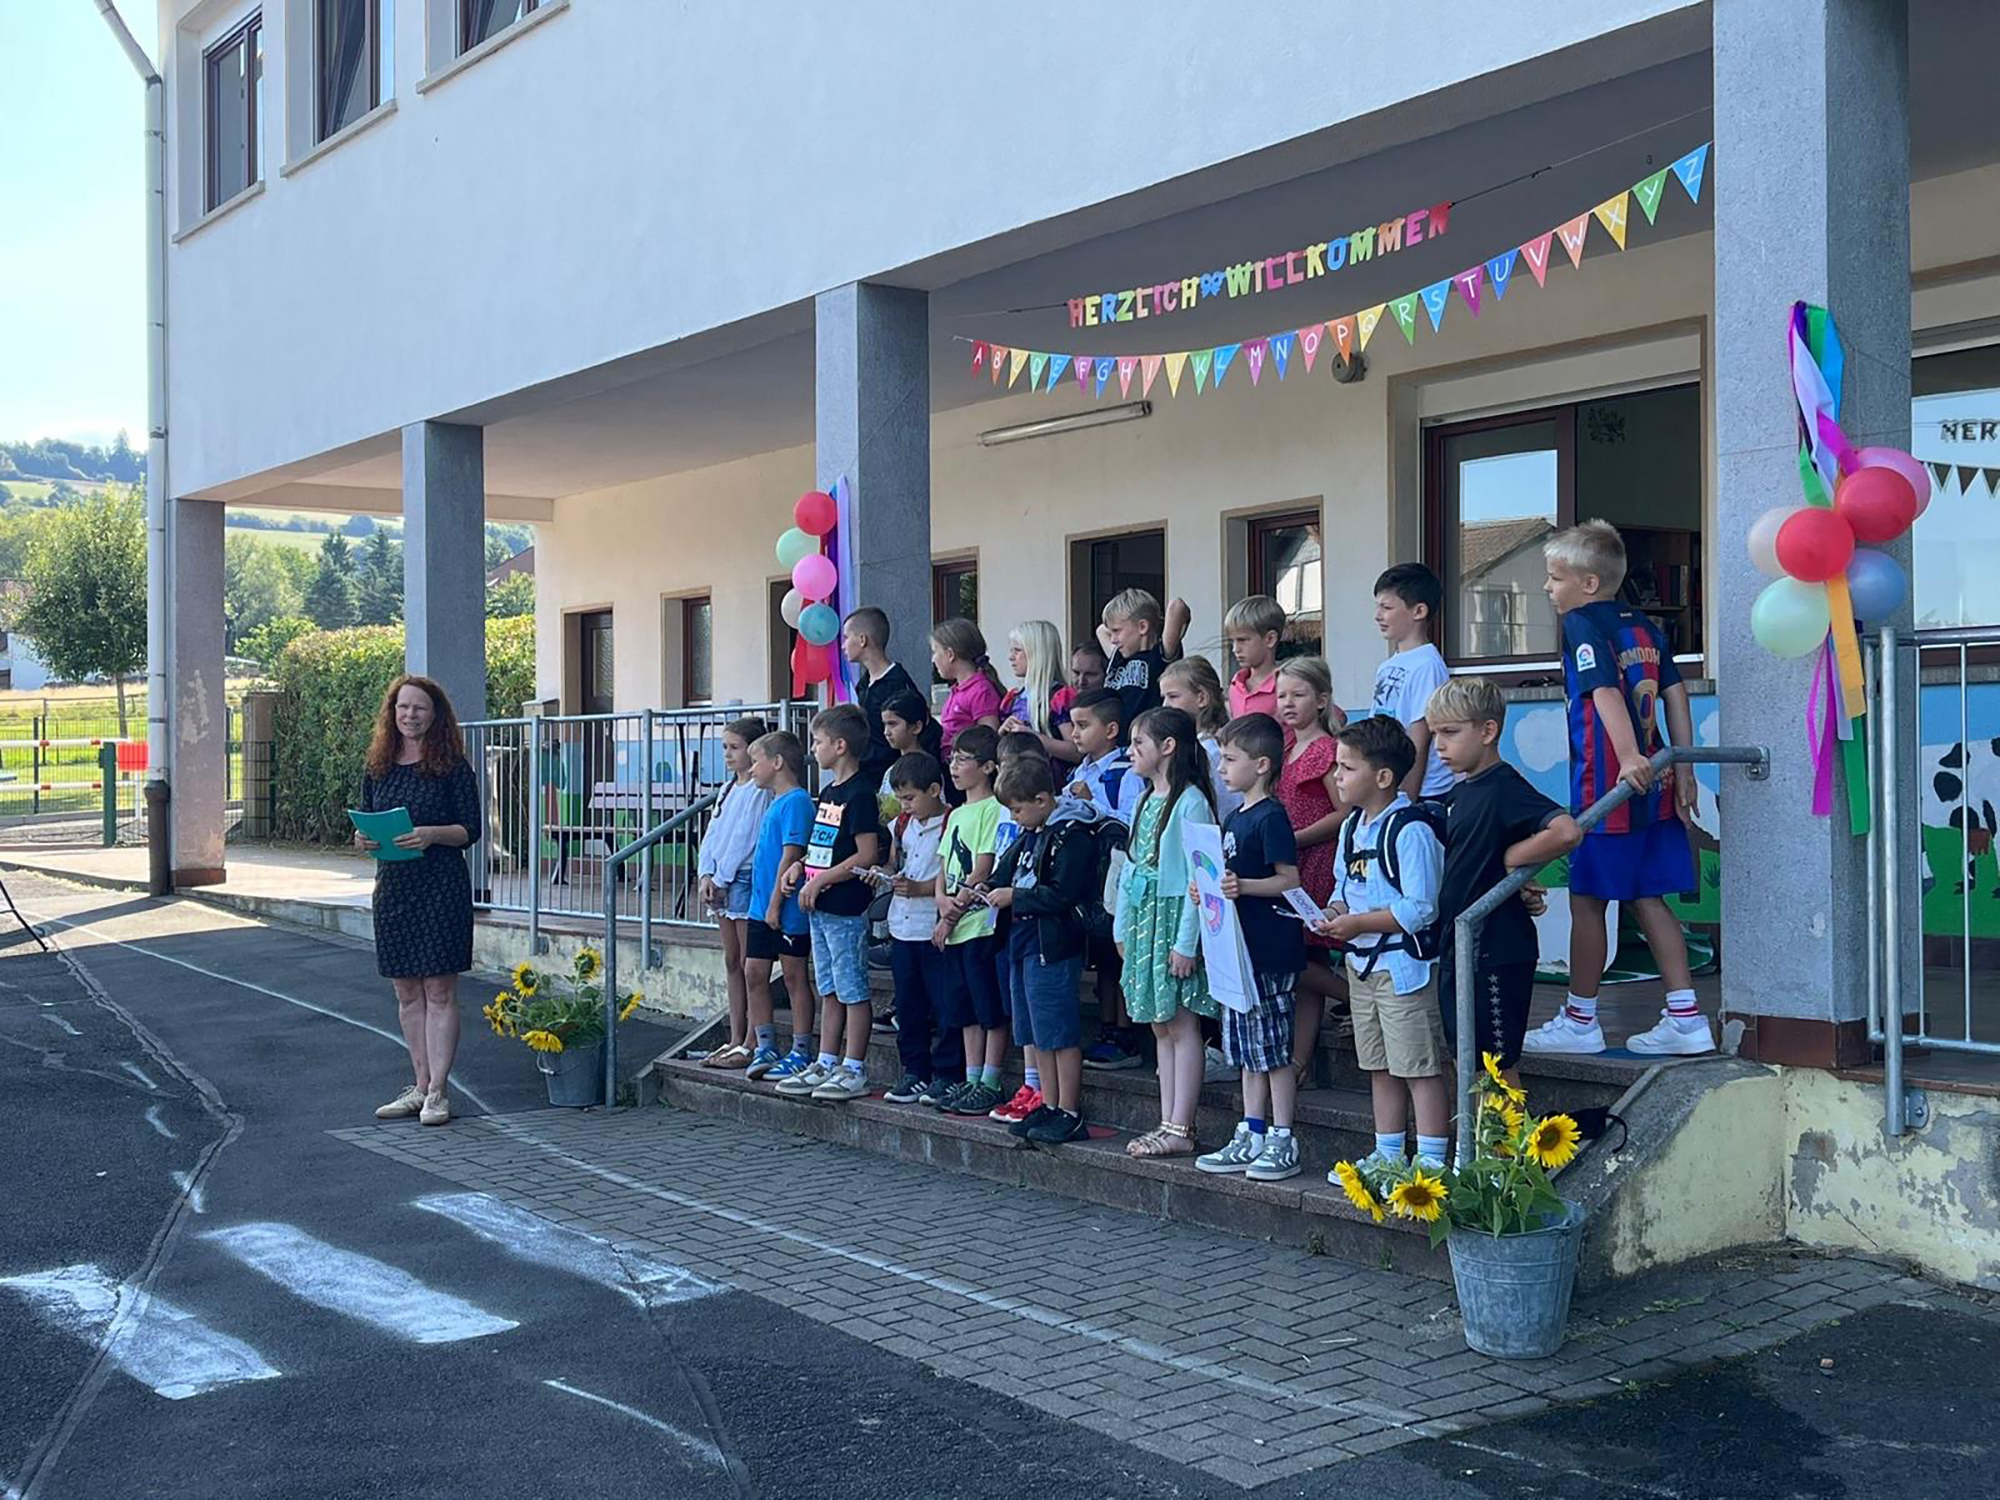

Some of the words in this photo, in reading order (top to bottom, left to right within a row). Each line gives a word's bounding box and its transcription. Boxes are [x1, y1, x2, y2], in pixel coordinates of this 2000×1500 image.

[1068, 276, 1200, 328] HERZLICH
[1225, 200, 1451, 298] WILLKOMMEN
[1079, 361, 1087, 380] F
[1097, 361, 1109, 381] G
[1122, 360, 1131, 378] H
[1195, 355, 1207, 377] K
[1250, 346, 1262, 367] M
[1276, 339, 1287, 361] N
[1305, 332, 1318, 354] O
[1336, 324, 1349, 346] P
[1398, 303, 1413, 326] R
[1429, 290, 1441, 312] S
[1461, 273, 1477, 299] T
[1495, 258, 1510, 282] U
[1529, 240, 1546, 267] V
[1563, 221, 1584, 250] W
[1605, 202, 1625, 231] X
[1643, 179, 1660, 206] Y
[1684, 156, 1701, 185] Z
